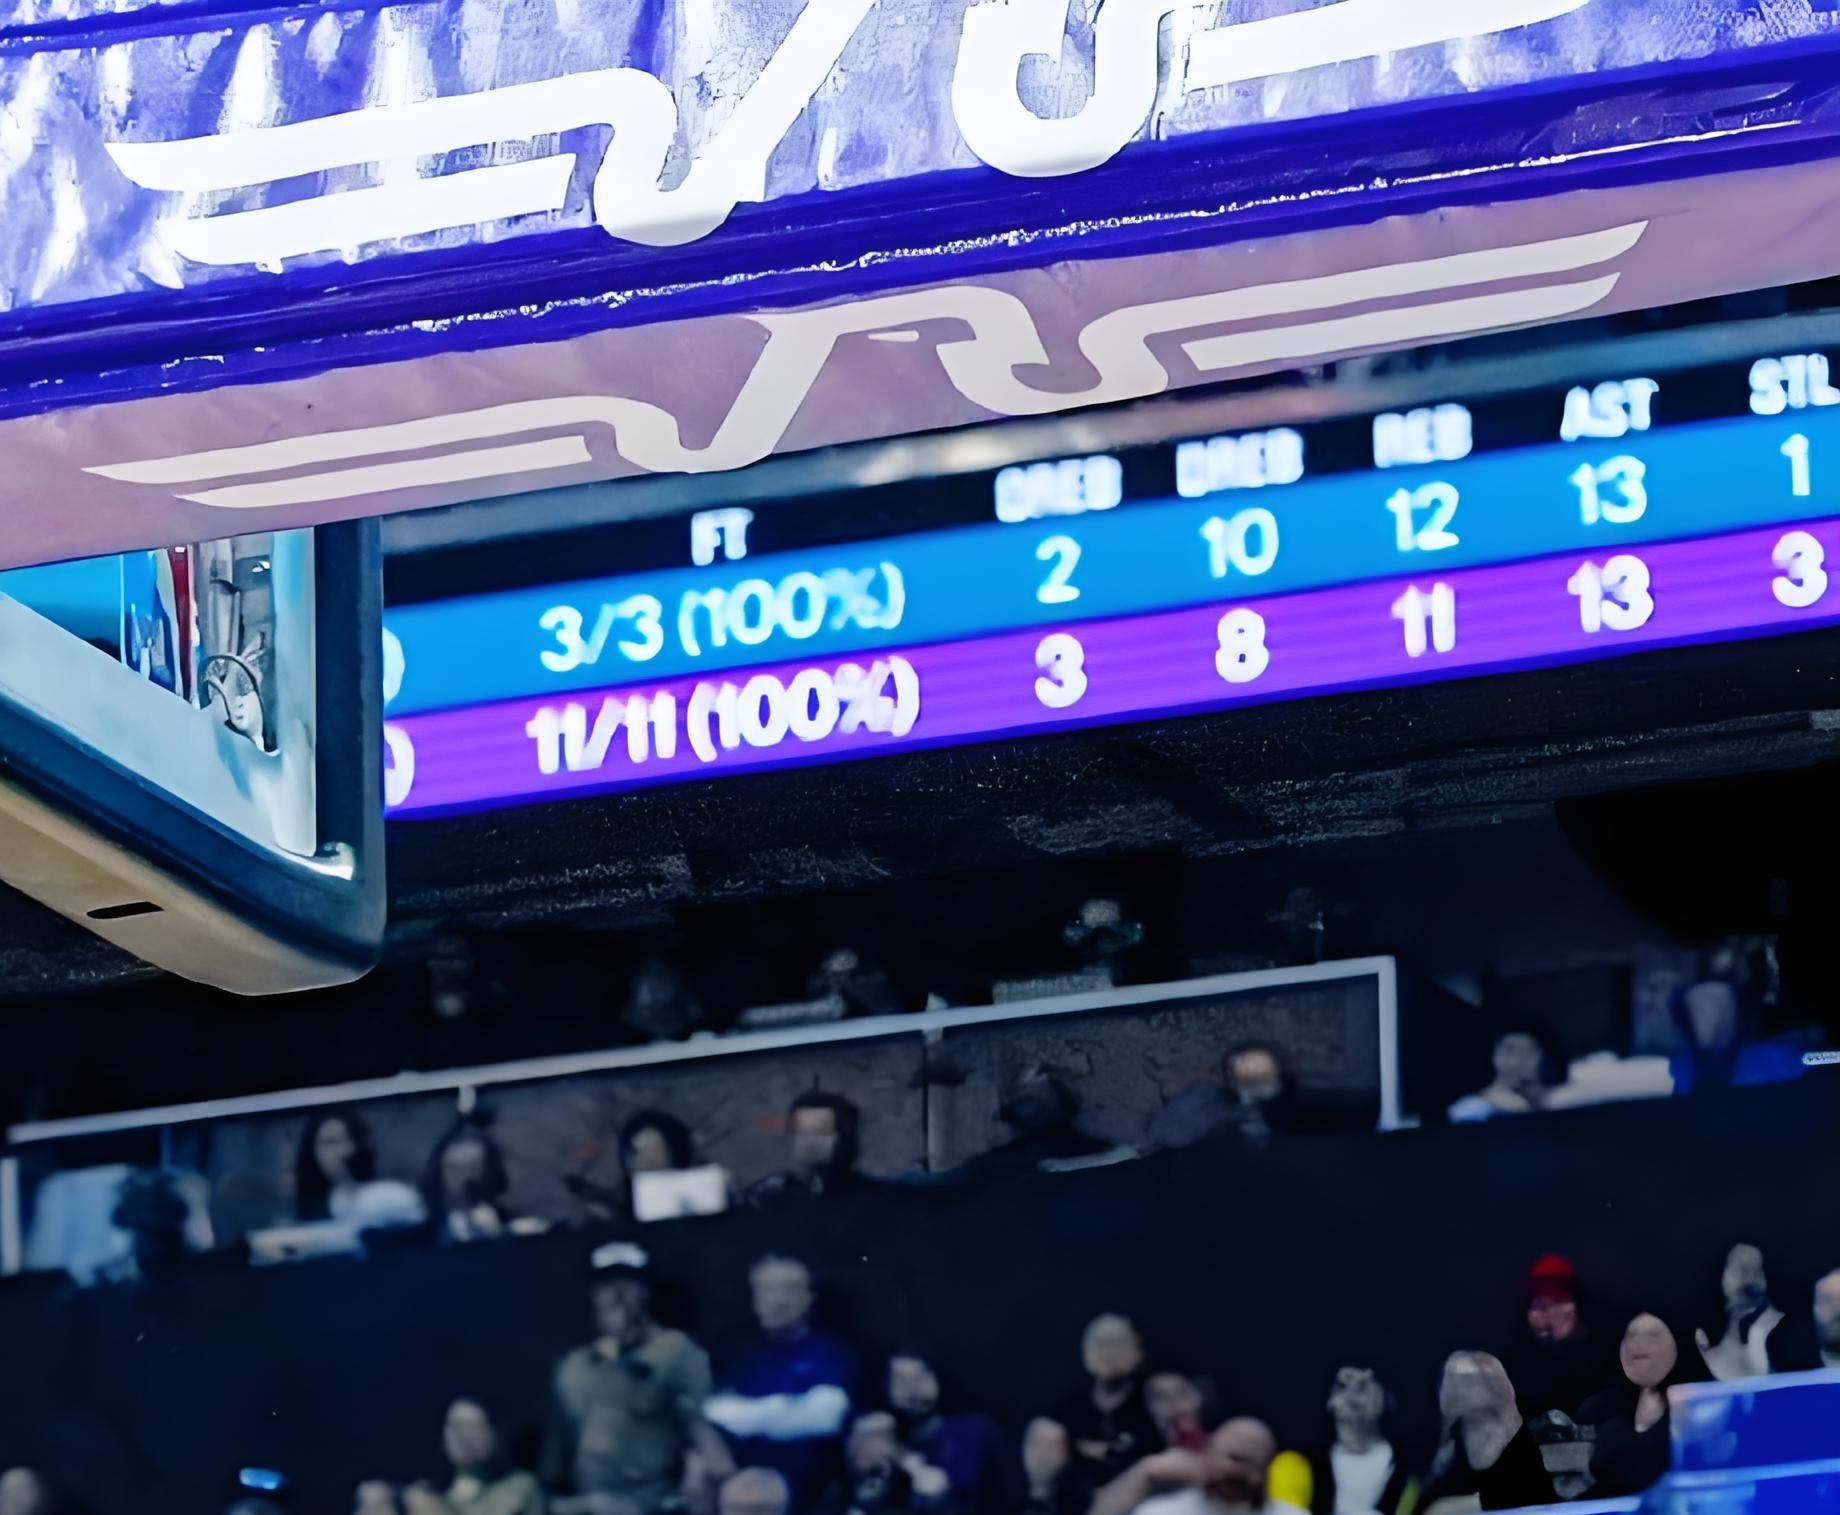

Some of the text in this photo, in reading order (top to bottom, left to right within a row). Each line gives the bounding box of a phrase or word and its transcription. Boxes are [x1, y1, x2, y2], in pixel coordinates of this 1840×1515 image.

[539, 433, 1811, 672] 3/3 (100%) 2 10 12 13 1
[690, 508, 754, 566] FT
[1561, 379, 1660, 441] AST
[1749, 353, 1840, 415] STL
[526, 530, 1828, 775] 11/11 (100%) 3 8 11 13 3
